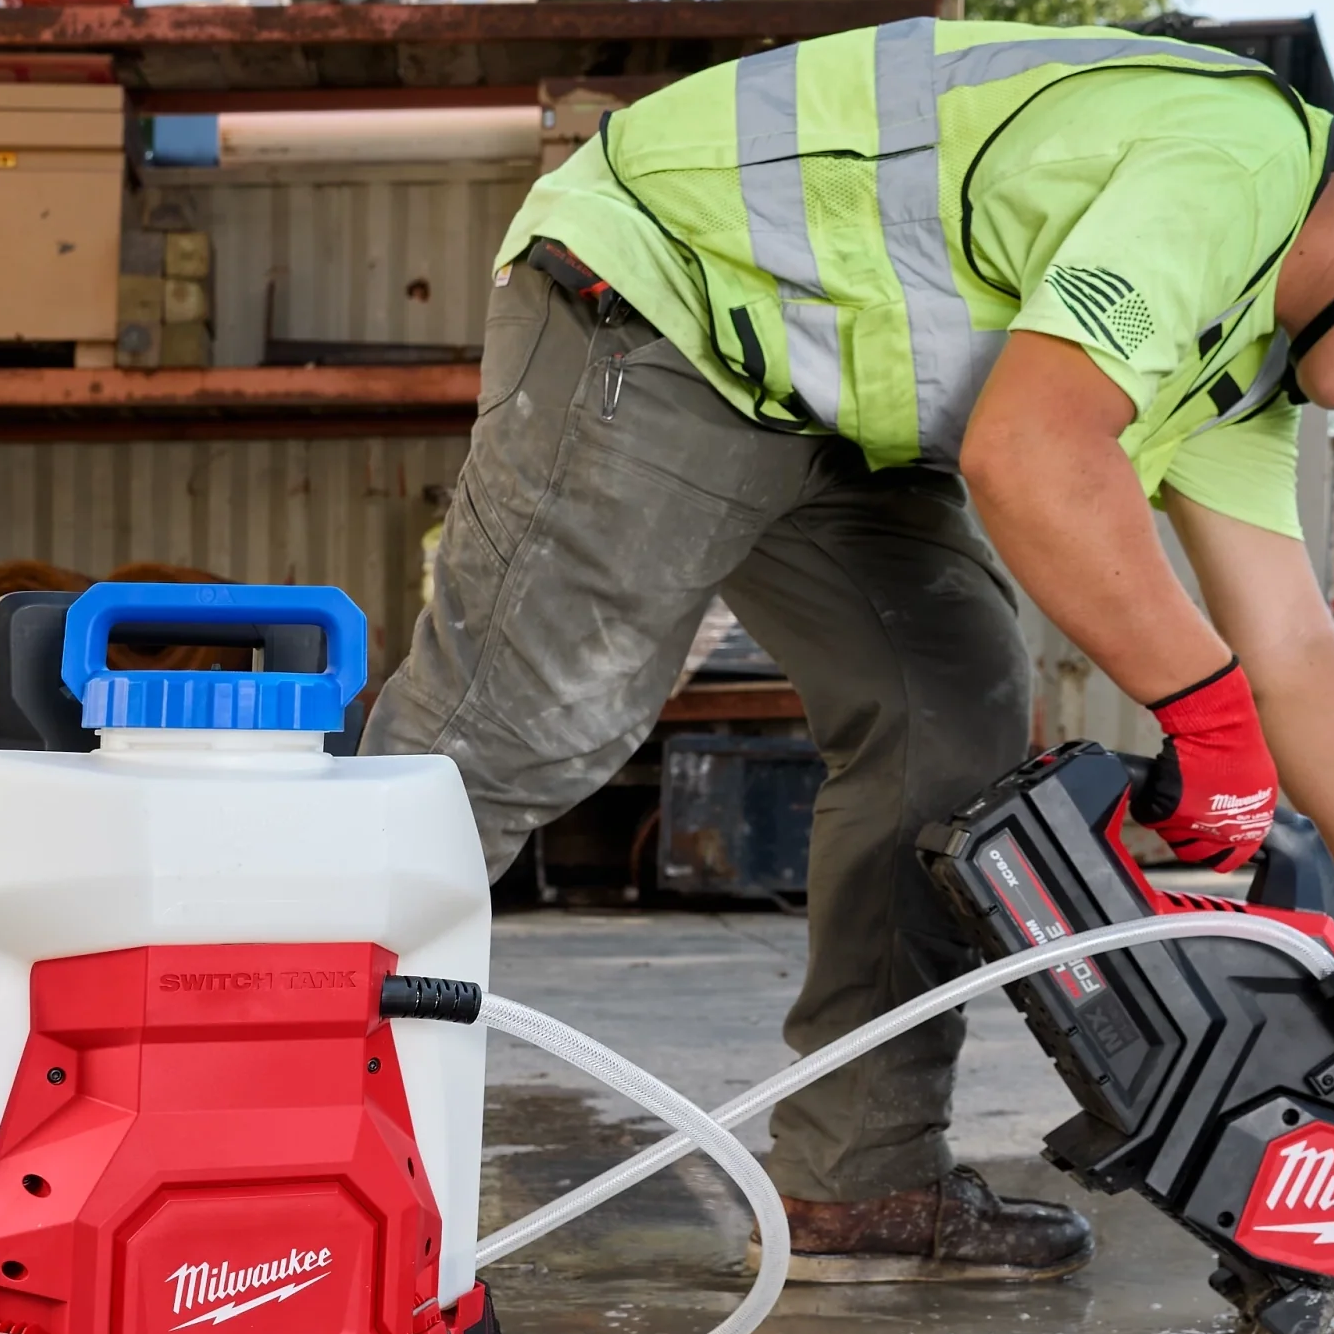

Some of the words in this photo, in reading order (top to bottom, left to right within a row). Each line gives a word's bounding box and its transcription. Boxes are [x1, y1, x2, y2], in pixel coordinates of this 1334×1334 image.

[159, 972, 273, 992] SWITCH
[280, 970, 357, 990] TANK
[1045, 922, 1101, 993] FOE
[164, 1247, 333, 1315] Milwaukee
